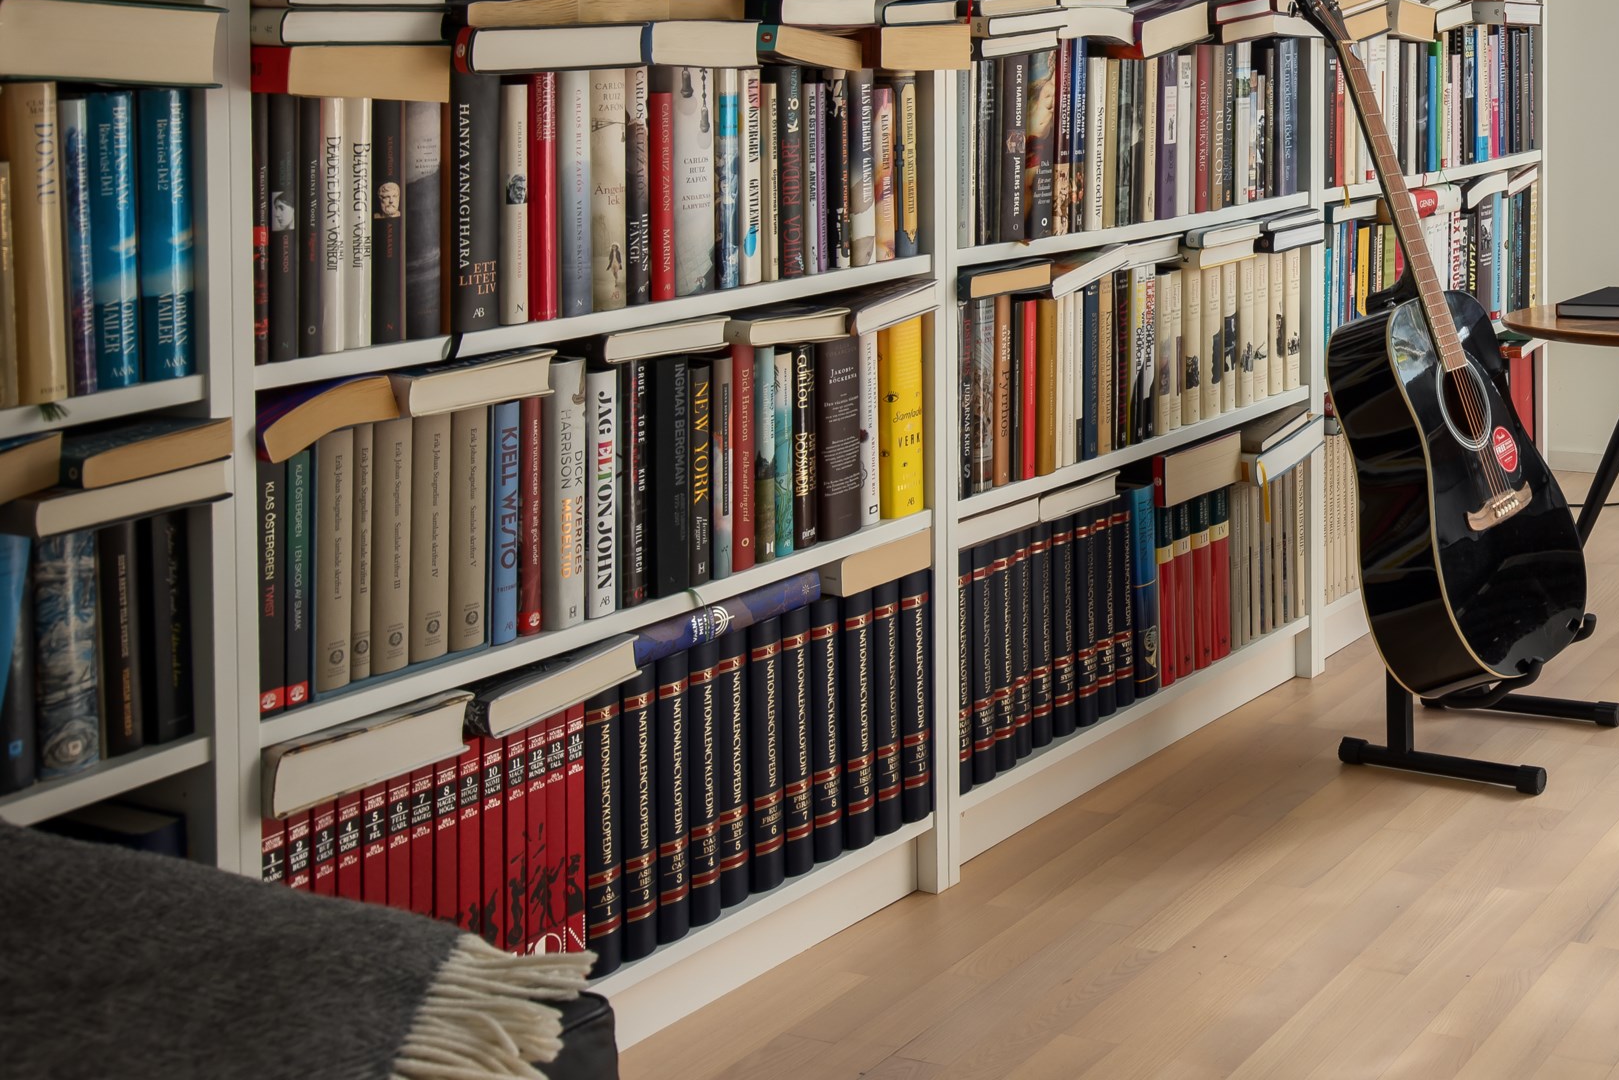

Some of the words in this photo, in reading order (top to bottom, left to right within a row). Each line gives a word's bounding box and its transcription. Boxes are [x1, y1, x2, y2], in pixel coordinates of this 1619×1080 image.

[459, 103, 470, 151] HANYA
[1215, 110, 1223, 186] RUBICON
[662, 145, 670, 172] RUIZ
[1013, 157, 1021, 192] JARLENS
[459, 155, 470, 269] YANAGIHARA
[662, 176, 670, 211] ZAFÓN
[1420, 198, 1435, 208] GENEN
[474, 260, 497, 274] ETT
[662, 229, 670, 272] MARINA
[460, 272, 497, 287] LITET
[477, 284, 496, 295] LIV
[675, 364, 685, 416] INGMAR
[694, 382, 708, 432] NEW
[597, 391, 613, 434] JAG
[638, 415, 644, 427] TO
[501, 427, 517, 485] KJELL
[561, 409, 572, 489] HARRISON
[638, 430, 645, 443] BE
[675, 419, 685, 487] BERGMAN
[899, 436, 920, 448] VERK
[574, 451, 582, 485] DICK
[597, 441, 613, 519] ELTON
[694, 445, 708, 504] YORK
[265, 482, 275, 512] KLAS
[264, 513, 276, 581] ÖSTERGREN
[500, 491, 516, 570] WESTÖ
[561, 499, 571, 578] MEDELTID
[574, 496, 582, 575] SVERIGES
[803, 528, 815, 540] pirat
[596, 522, 613, 591] JOHN
[264, 585, 274, 618] TWIST
[571, 735, 580, 745] 14
[768, 660, 776, 787] NATIONALENCYKLOPEDIN
[489, 766, 498, 778] 10
[512, 758, 521, 768] 11
[444, 785, 450, 796] 8
[599, 724, 612, 865] NATIONALENCYKLOPEDIN
